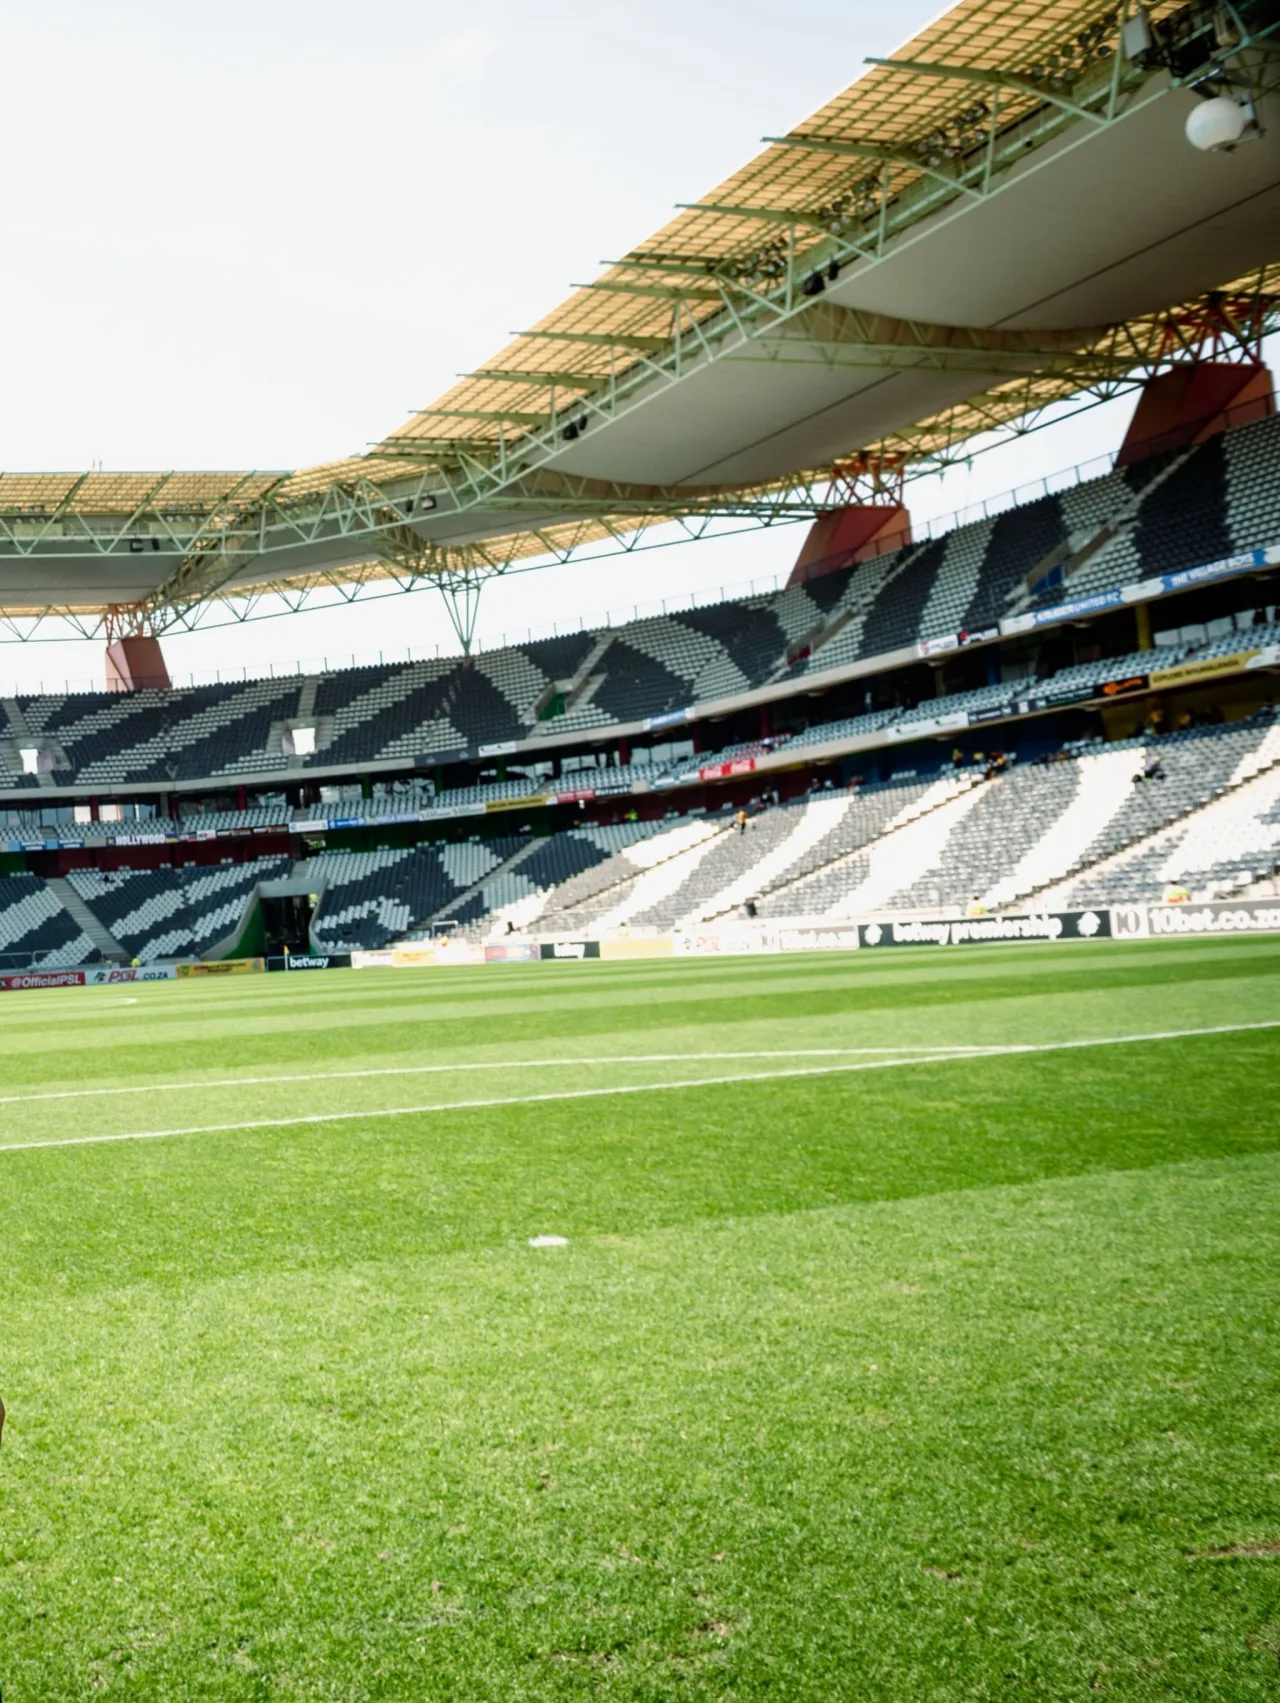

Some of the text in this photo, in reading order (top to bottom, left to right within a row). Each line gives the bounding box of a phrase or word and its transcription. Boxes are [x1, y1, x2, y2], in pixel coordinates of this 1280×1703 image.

[115, 834, 166, 846] HOLLYWOOD
[289, 956, 329, 968] betway
[11, 974, 81, 989] @OfficialPSL
